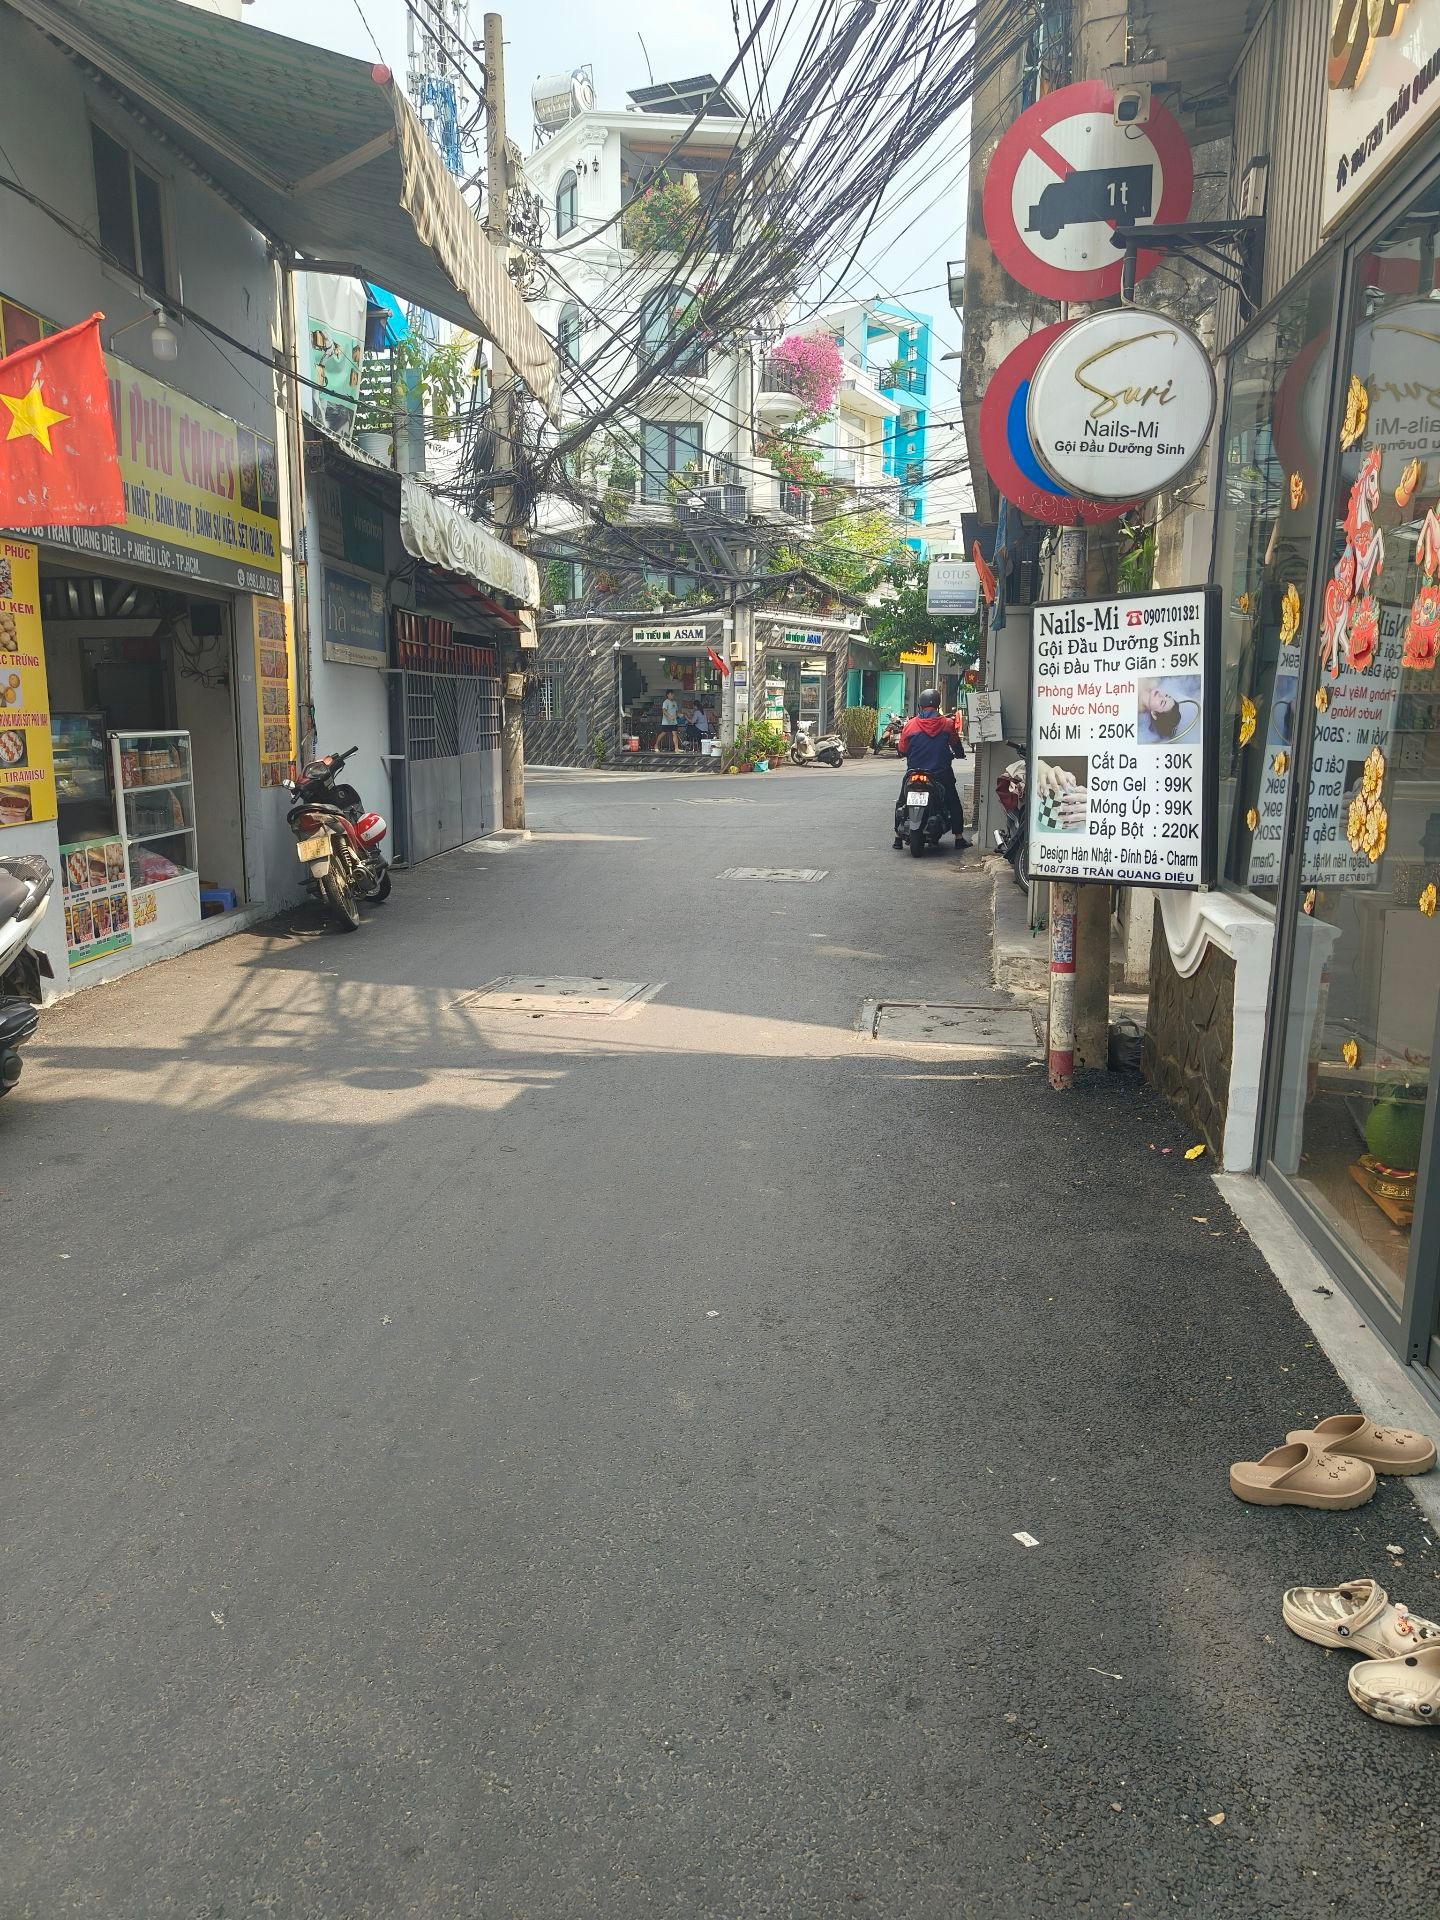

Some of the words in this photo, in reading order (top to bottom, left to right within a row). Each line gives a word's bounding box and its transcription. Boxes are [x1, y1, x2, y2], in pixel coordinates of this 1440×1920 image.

[1106, 181, 1129, 206] 1t
[1074, 330, 1179, 419] Suri
[1084, 419, 1160, 439] Nails-Mi
[179, 413, 235, 500] CAKES
[1054, 441, 1077, 456] Gội
[1079, 439, 1105, 453] Đầu
[1108, 442, 1153, 457] Dưỡng
[1156, 443, 1185, 455] Sinh
[155, 487, 174, 526] BÁNH
[4, 543, 31, 560] PHÚC
[73, 526, 100, 551] QUANG
[102, 530, 121, 556] DIỆU
[157, 546, 170, 569] LỘC
[937, 570, 970, 579] LOTUS
[10, 602, 34, 615] KEM
[1040, 606, 1119, 636] Nails-Mi
[1144, 605, 1200, 626] 0907101321
[646, 629, 661, 640] TIẾU
[674, 629, 704, 639] ASAM
[806, 633, 821, 644] ASAM
[1039, 639, 1062, 658] Gội
[1068, 638, 1097, 654] Đầu
[1103, 636, 1159, 653] Dưỡng
[1164, 629, 1200, 647] Sinh
[9, 653, 40, 667] TRỨNG
[1039, 661, 1059, 677] Gội
[1064, 659, 1089, 674] Đầu
[1094, 659, 1120, 672] Thư
[1125, 656, 1156, 670] Giãn
[1171, 653, 1199, 667] 59K
[1038, 684, 1073, 698] Phòng
[1077, 683, 1102, 696] Máy
[1106, 682, 1135, 695] Lạnh
[1053, 703, 1084, 716] Nước
[1089, 703, 1119, 716] Nóng
[1040, 723, 1060, 739] Nối
[1066, 725, 1080, 739] Mi
[1099, 724, 1135, 738] 250K
[1092, 752, 1114, 769] Cắt
[1119, 755, 1137, 769] Da
[1165, 754, 1192, 769] 30K
[4, 769, 45, 783] TIRAMISU
[1091, 777, 1117, 791] Sơn
[1123, 777, 1146, 791] Gel
[1165, 777, 1192, 792] 99K
[1090, 799, 1127, 817] Móng
[1132, 796, 1151, 817] Úp
[1165, 800, 1192, 815] 99K
[1089, 818, 1116, 839] Đắp
[1121, 822, 1143, 839] Bột
[1162, 823, 1199, 839] 220K
[1040, 845, 1068, 863] Design
[1071, 847, 1088, 861] Hàn
[1092, 848, 1112, 865] Nhật
[1121, 849, 1141, 864] Đính
[1145, 850, 1157, 864] Đá
[1167, 851, 1197, 866] Charm
[1038, 864, 1079, 874] 108/73B
[1117, 869, 1160, 880] QUANG
[1165, 872, 1194, 884] DIỆU
